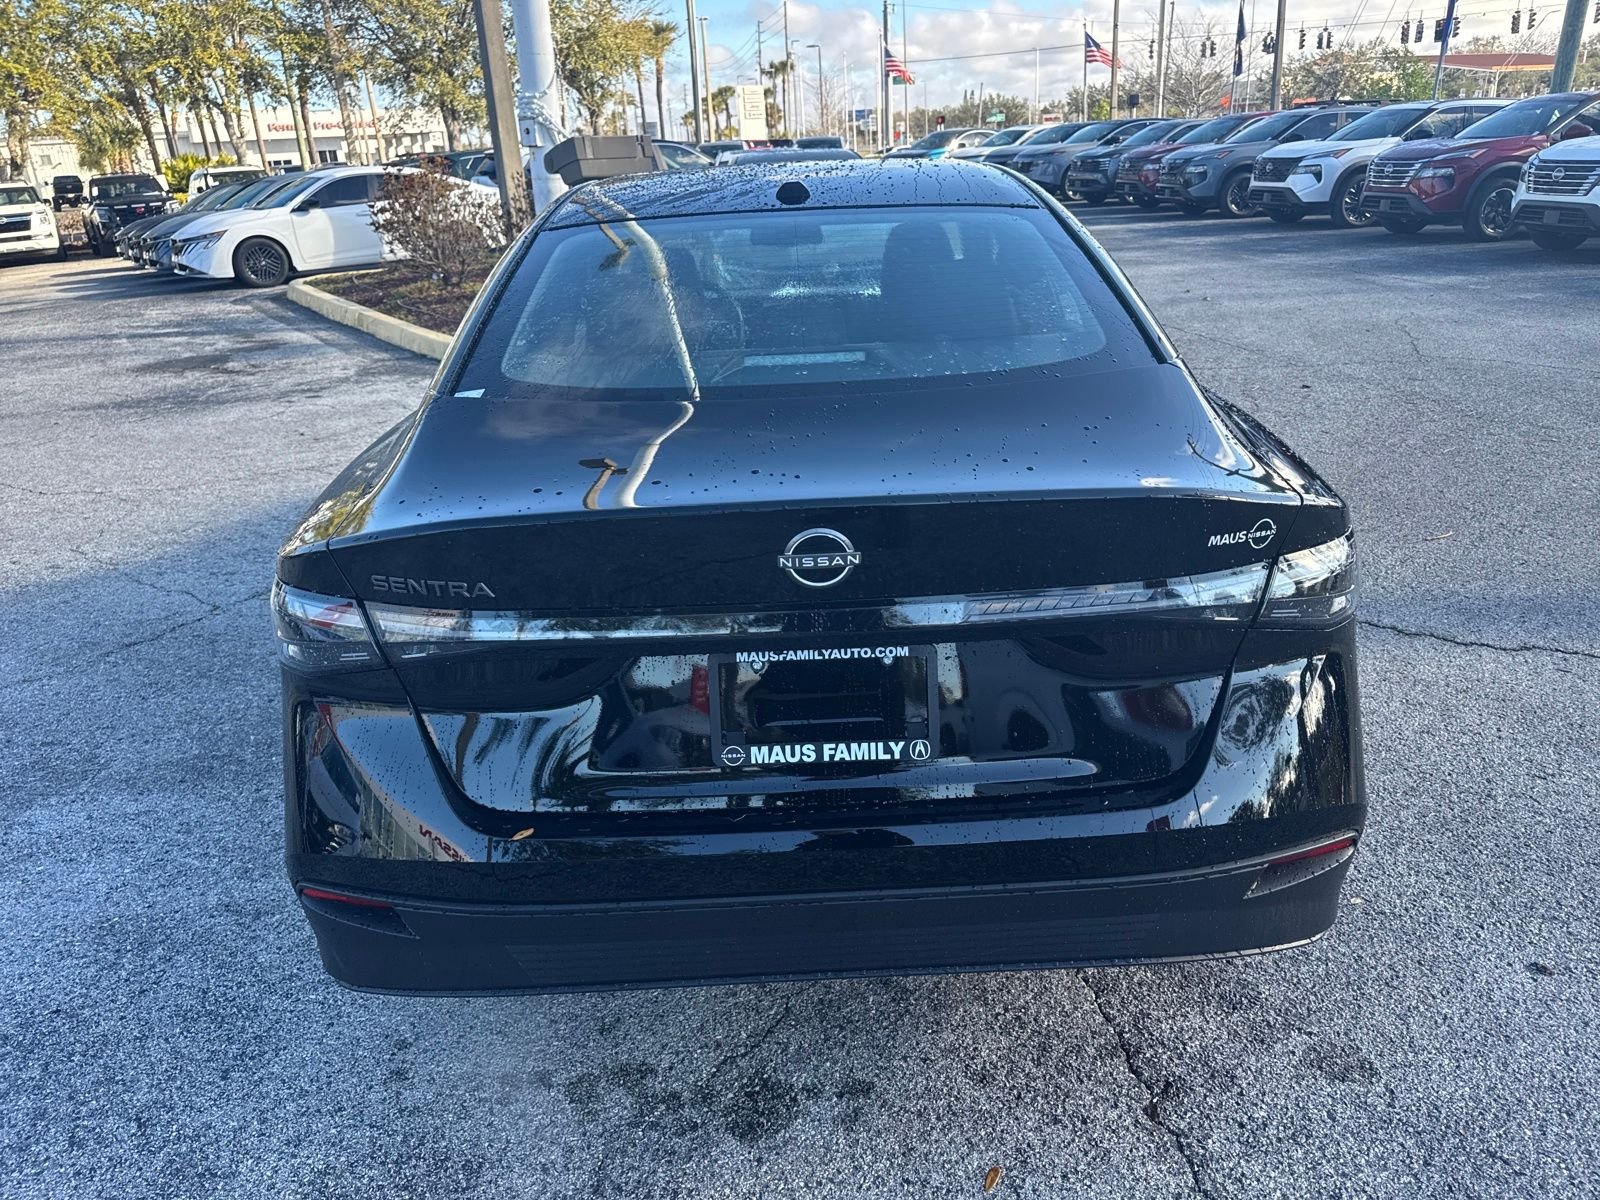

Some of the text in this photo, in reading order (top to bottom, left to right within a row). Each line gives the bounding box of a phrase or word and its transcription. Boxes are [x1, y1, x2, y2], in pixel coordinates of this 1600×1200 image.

[1207, 528, 1277, 547] MAUS NISSAN
[779, 554, 860, 567] NISSAN
[371, 574, 496, 598] SENTRA
[735, 646, 909, 663] MAUSFAMILYAUTO.COM
[750, 741, 905, 764] MAUS FAMILY
